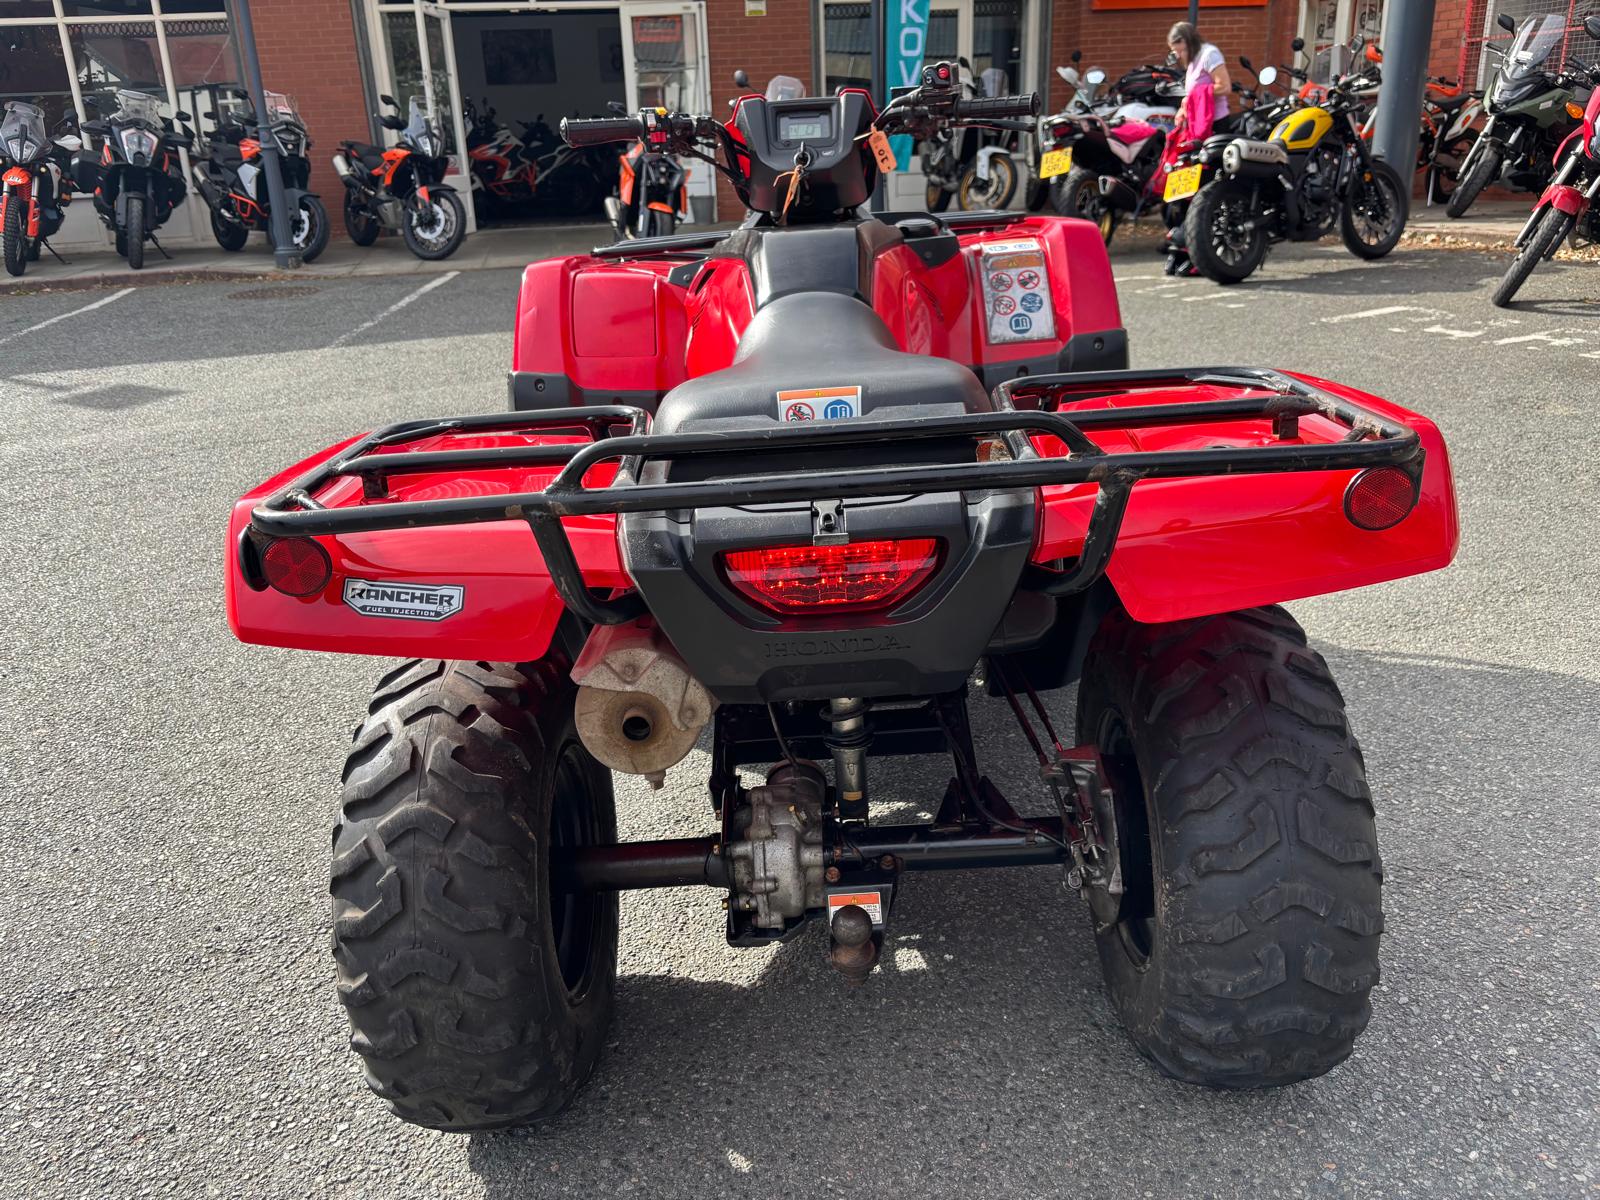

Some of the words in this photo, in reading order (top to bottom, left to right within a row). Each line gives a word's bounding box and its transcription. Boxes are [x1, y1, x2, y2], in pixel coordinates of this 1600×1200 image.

[350, 587, 455, 606] RANCHER
[390, 608, 436, 617] INJECTION
[764, 635, 912, 658] HONDA
